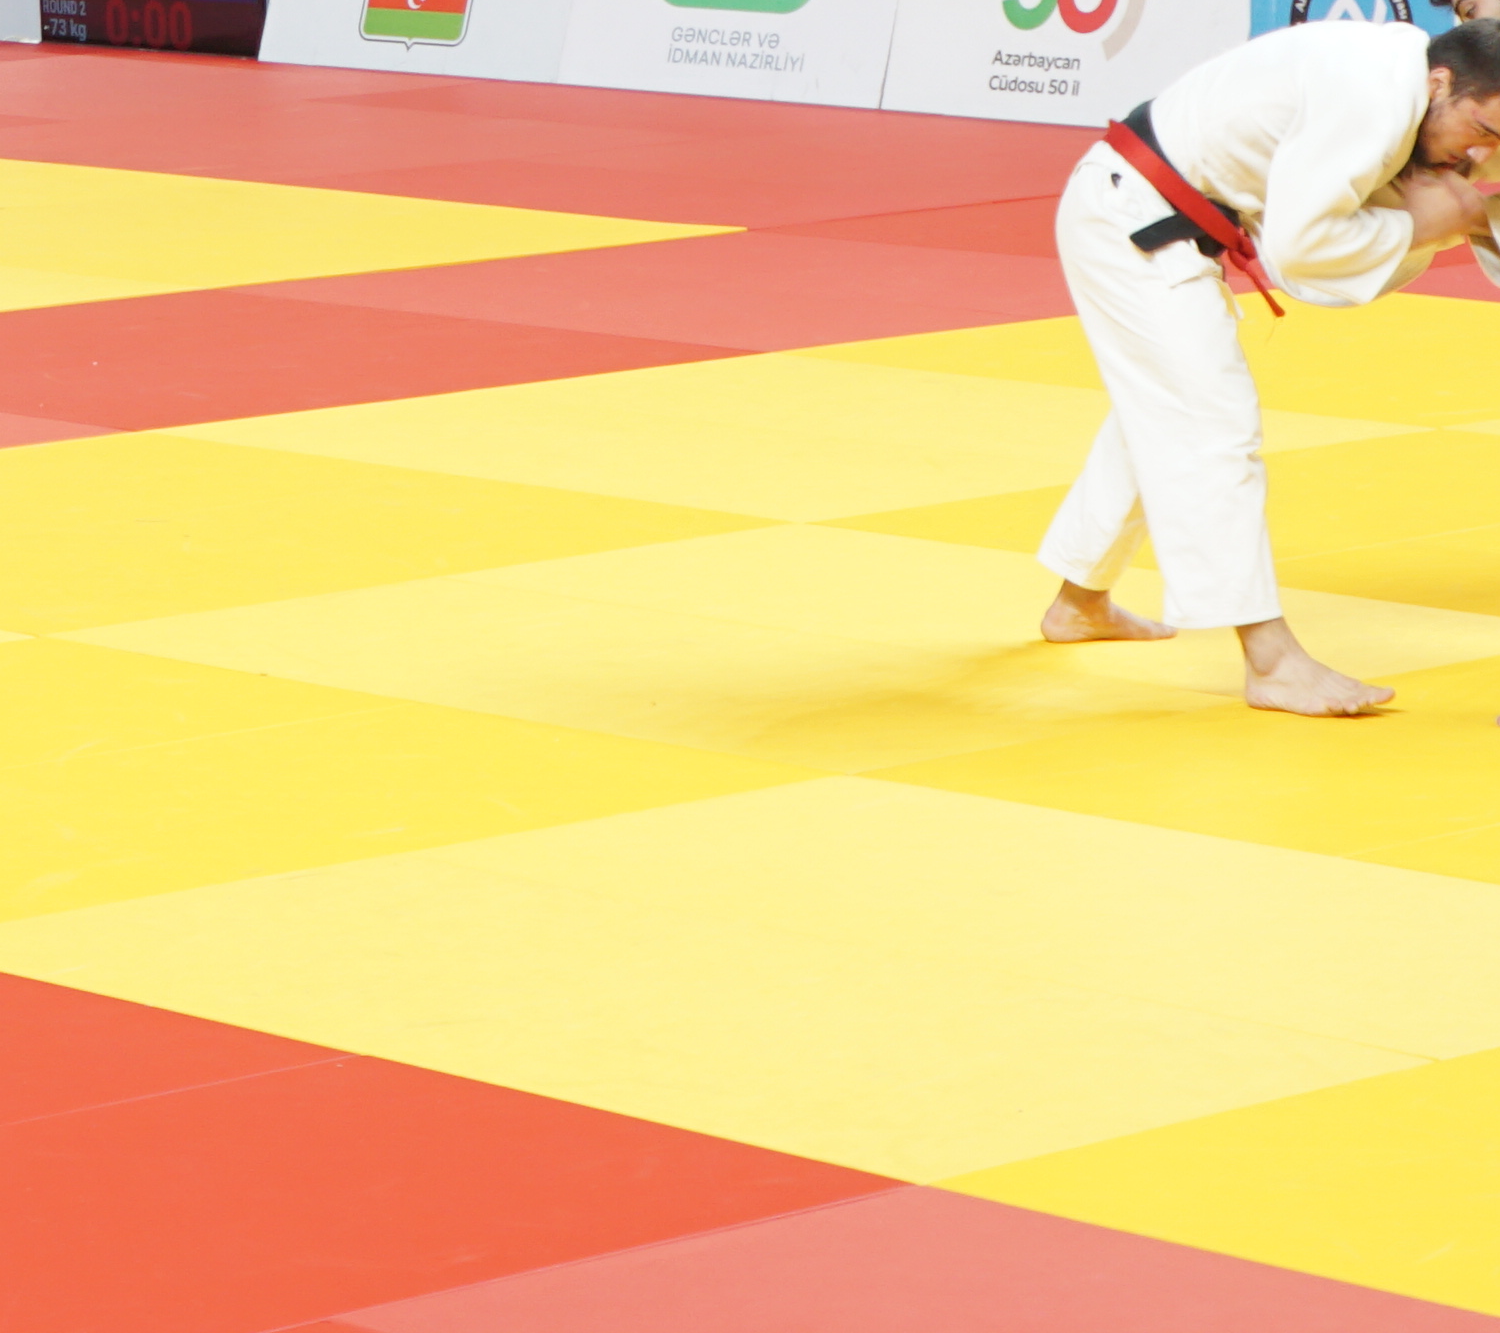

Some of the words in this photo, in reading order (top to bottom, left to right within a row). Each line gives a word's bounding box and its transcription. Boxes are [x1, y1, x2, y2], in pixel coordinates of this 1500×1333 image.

[79, 1, 87, 16] 2
[69, 19, 88, 42] kg
[671, 26, 753, 49] GƏNCLƏR
[756, 31, 781, 50] VƏ
[667, 47, 723, 67] İDMAN
[725, 49, 805, 74] NAZİRLİYİ
[991, 49, 1081, 72] Azərbaycan
[988, 75, 1045, 94] Cüdosu
[1047, 78, 1068, 95] 50
[1071, 80, 1081, 96] il
